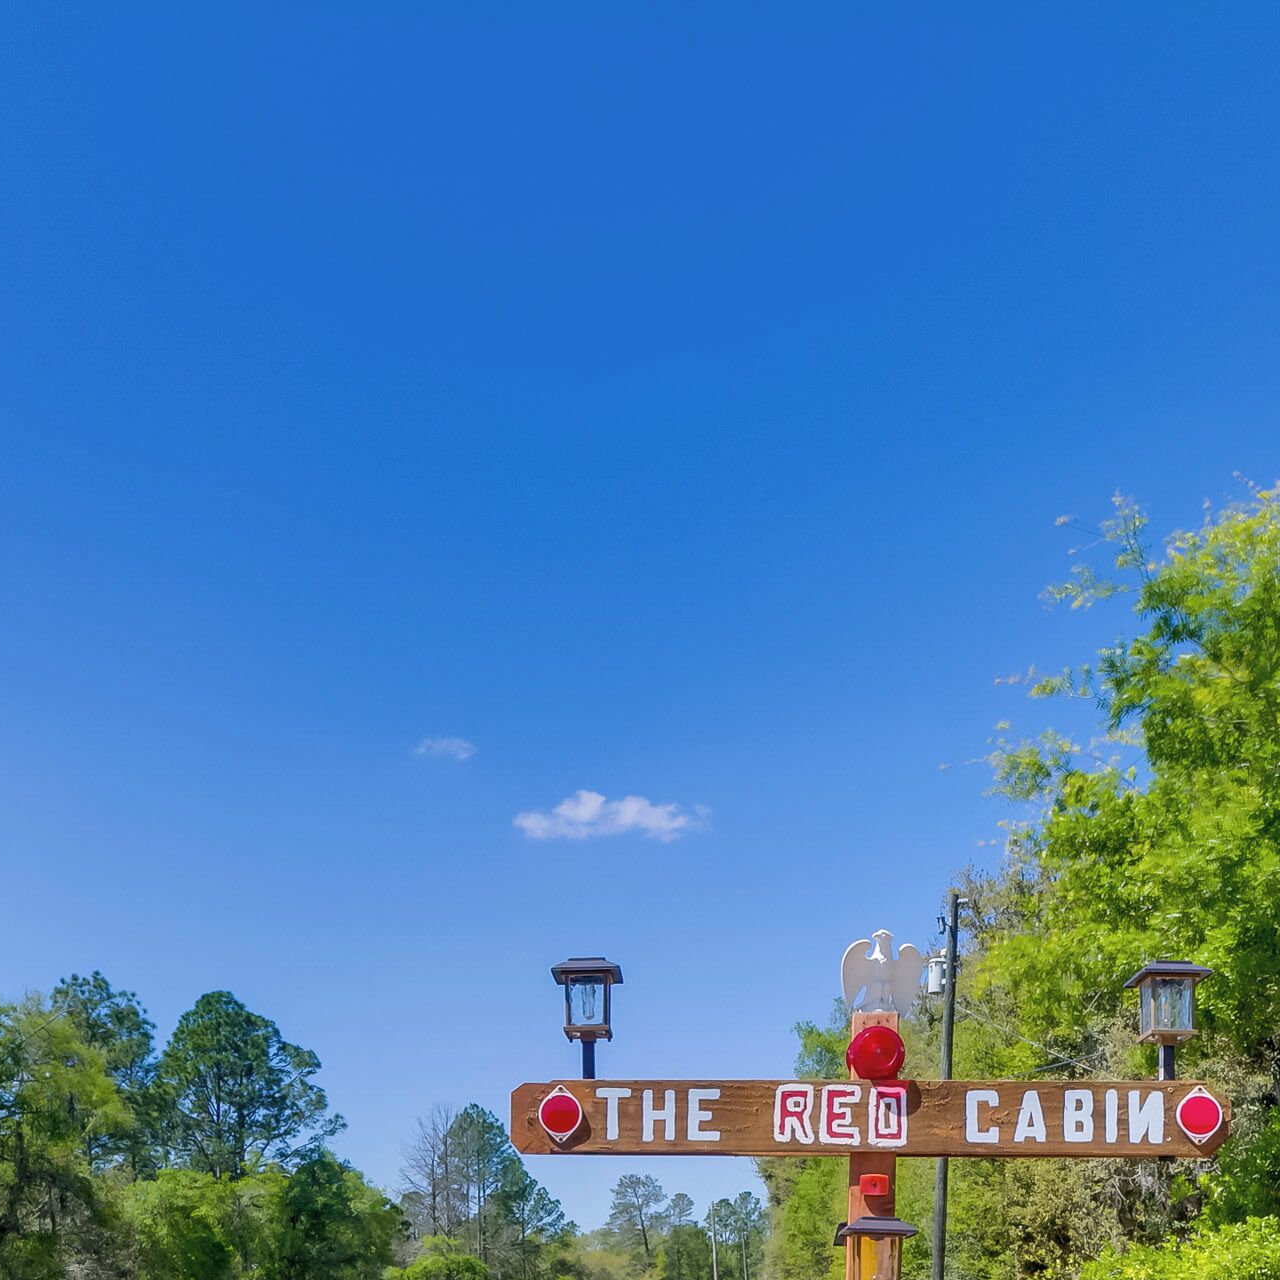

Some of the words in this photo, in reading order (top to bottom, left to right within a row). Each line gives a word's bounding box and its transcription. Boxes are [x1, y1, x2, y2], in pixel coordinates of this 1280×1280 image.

[595, 1087, 721, 1143] THE
[773, 1083, 908, 1147] RED
[964, 1088, 1165, 1144] CABIN
